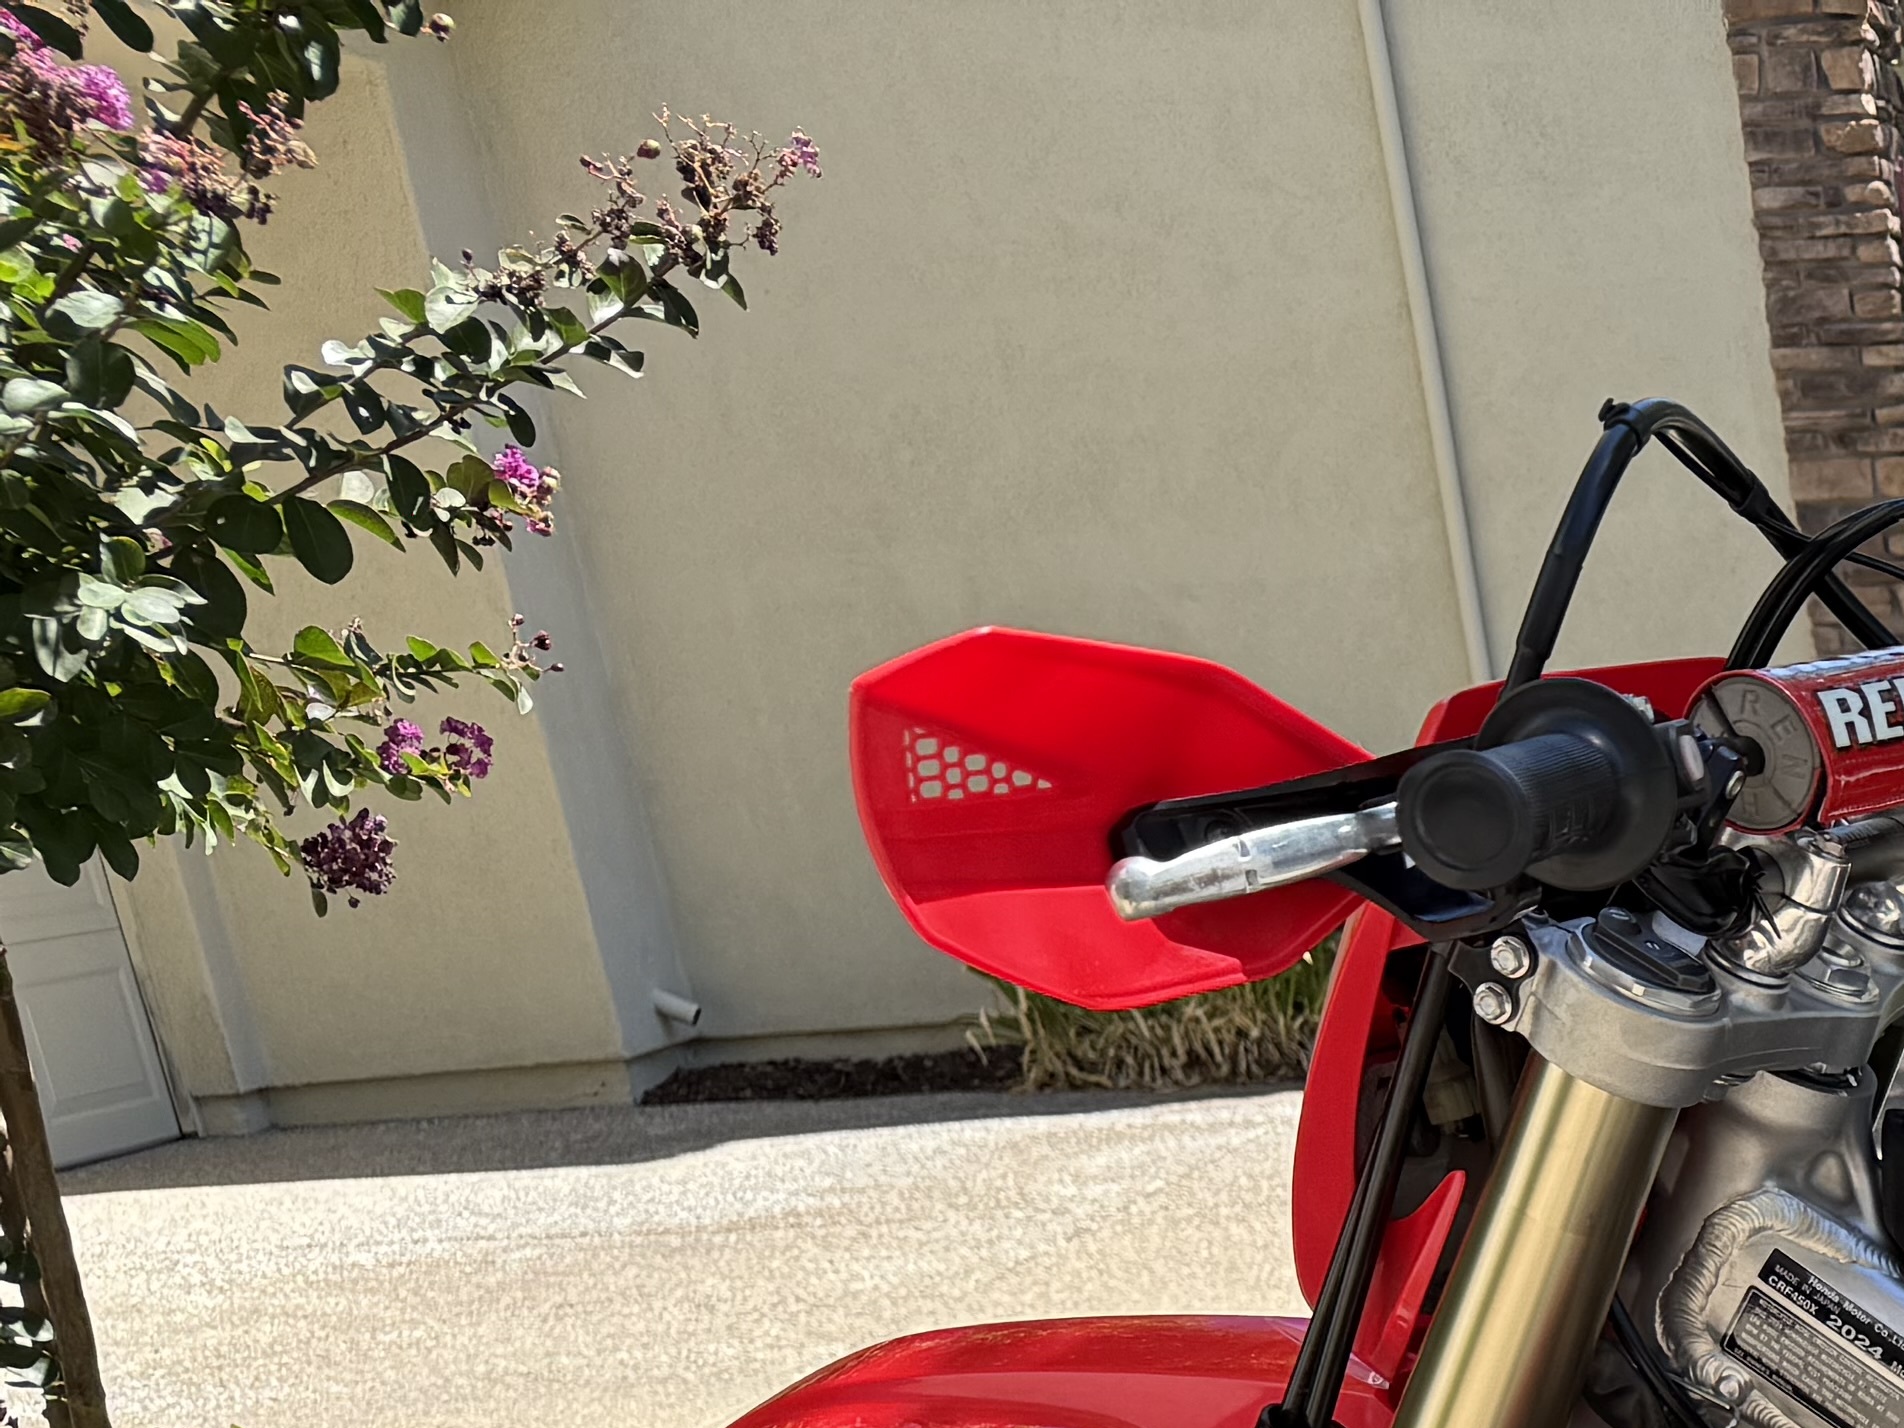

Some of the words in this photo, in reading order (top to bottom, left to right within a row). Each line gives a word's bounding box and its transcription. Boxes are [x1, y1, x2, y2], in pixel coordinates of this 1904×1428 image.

[1775, 1264, 1800, 1285] MADE
[1801, 1283, 1812, 1295] IN
[1813, 1293, 1841, 1314] JAPAN
[1808, 1275, 1840, 1303] Honda
[1843, 1299, 1872, 1326] Motor
[1768, 1276, 1819, 1315] CRF450X
[1825, 1314, 1884, 1360] 2024
